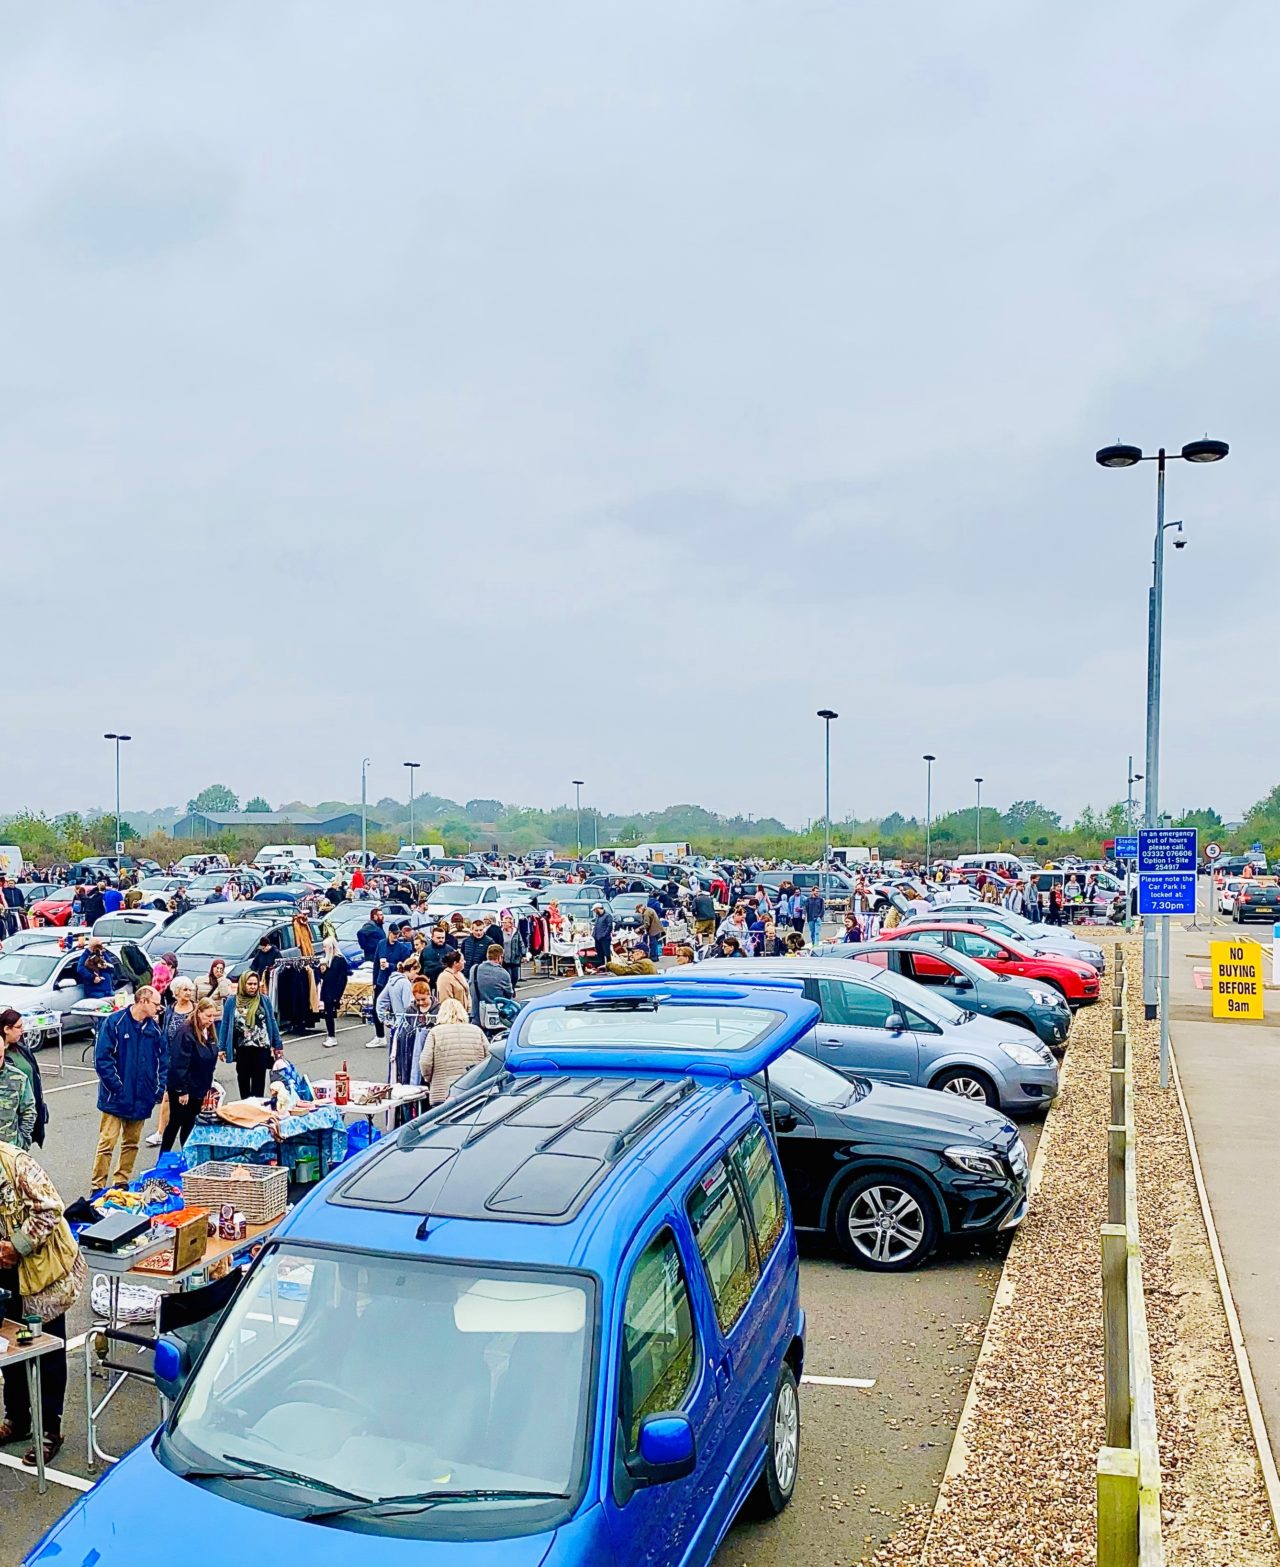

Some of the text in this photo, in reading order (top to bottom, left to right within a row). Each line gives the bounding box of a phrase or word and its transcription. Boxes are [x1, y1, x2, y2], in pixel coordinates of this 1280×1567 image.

[1151, 901, 1184, 910] 7.30pm
[1230, 947, 1244, 961] NO
[1218, 964, 1256, 978] BUYING
[1218, 981, 1257, 995] BEFORE
[1228, 998, 1250, 1012] 9am
